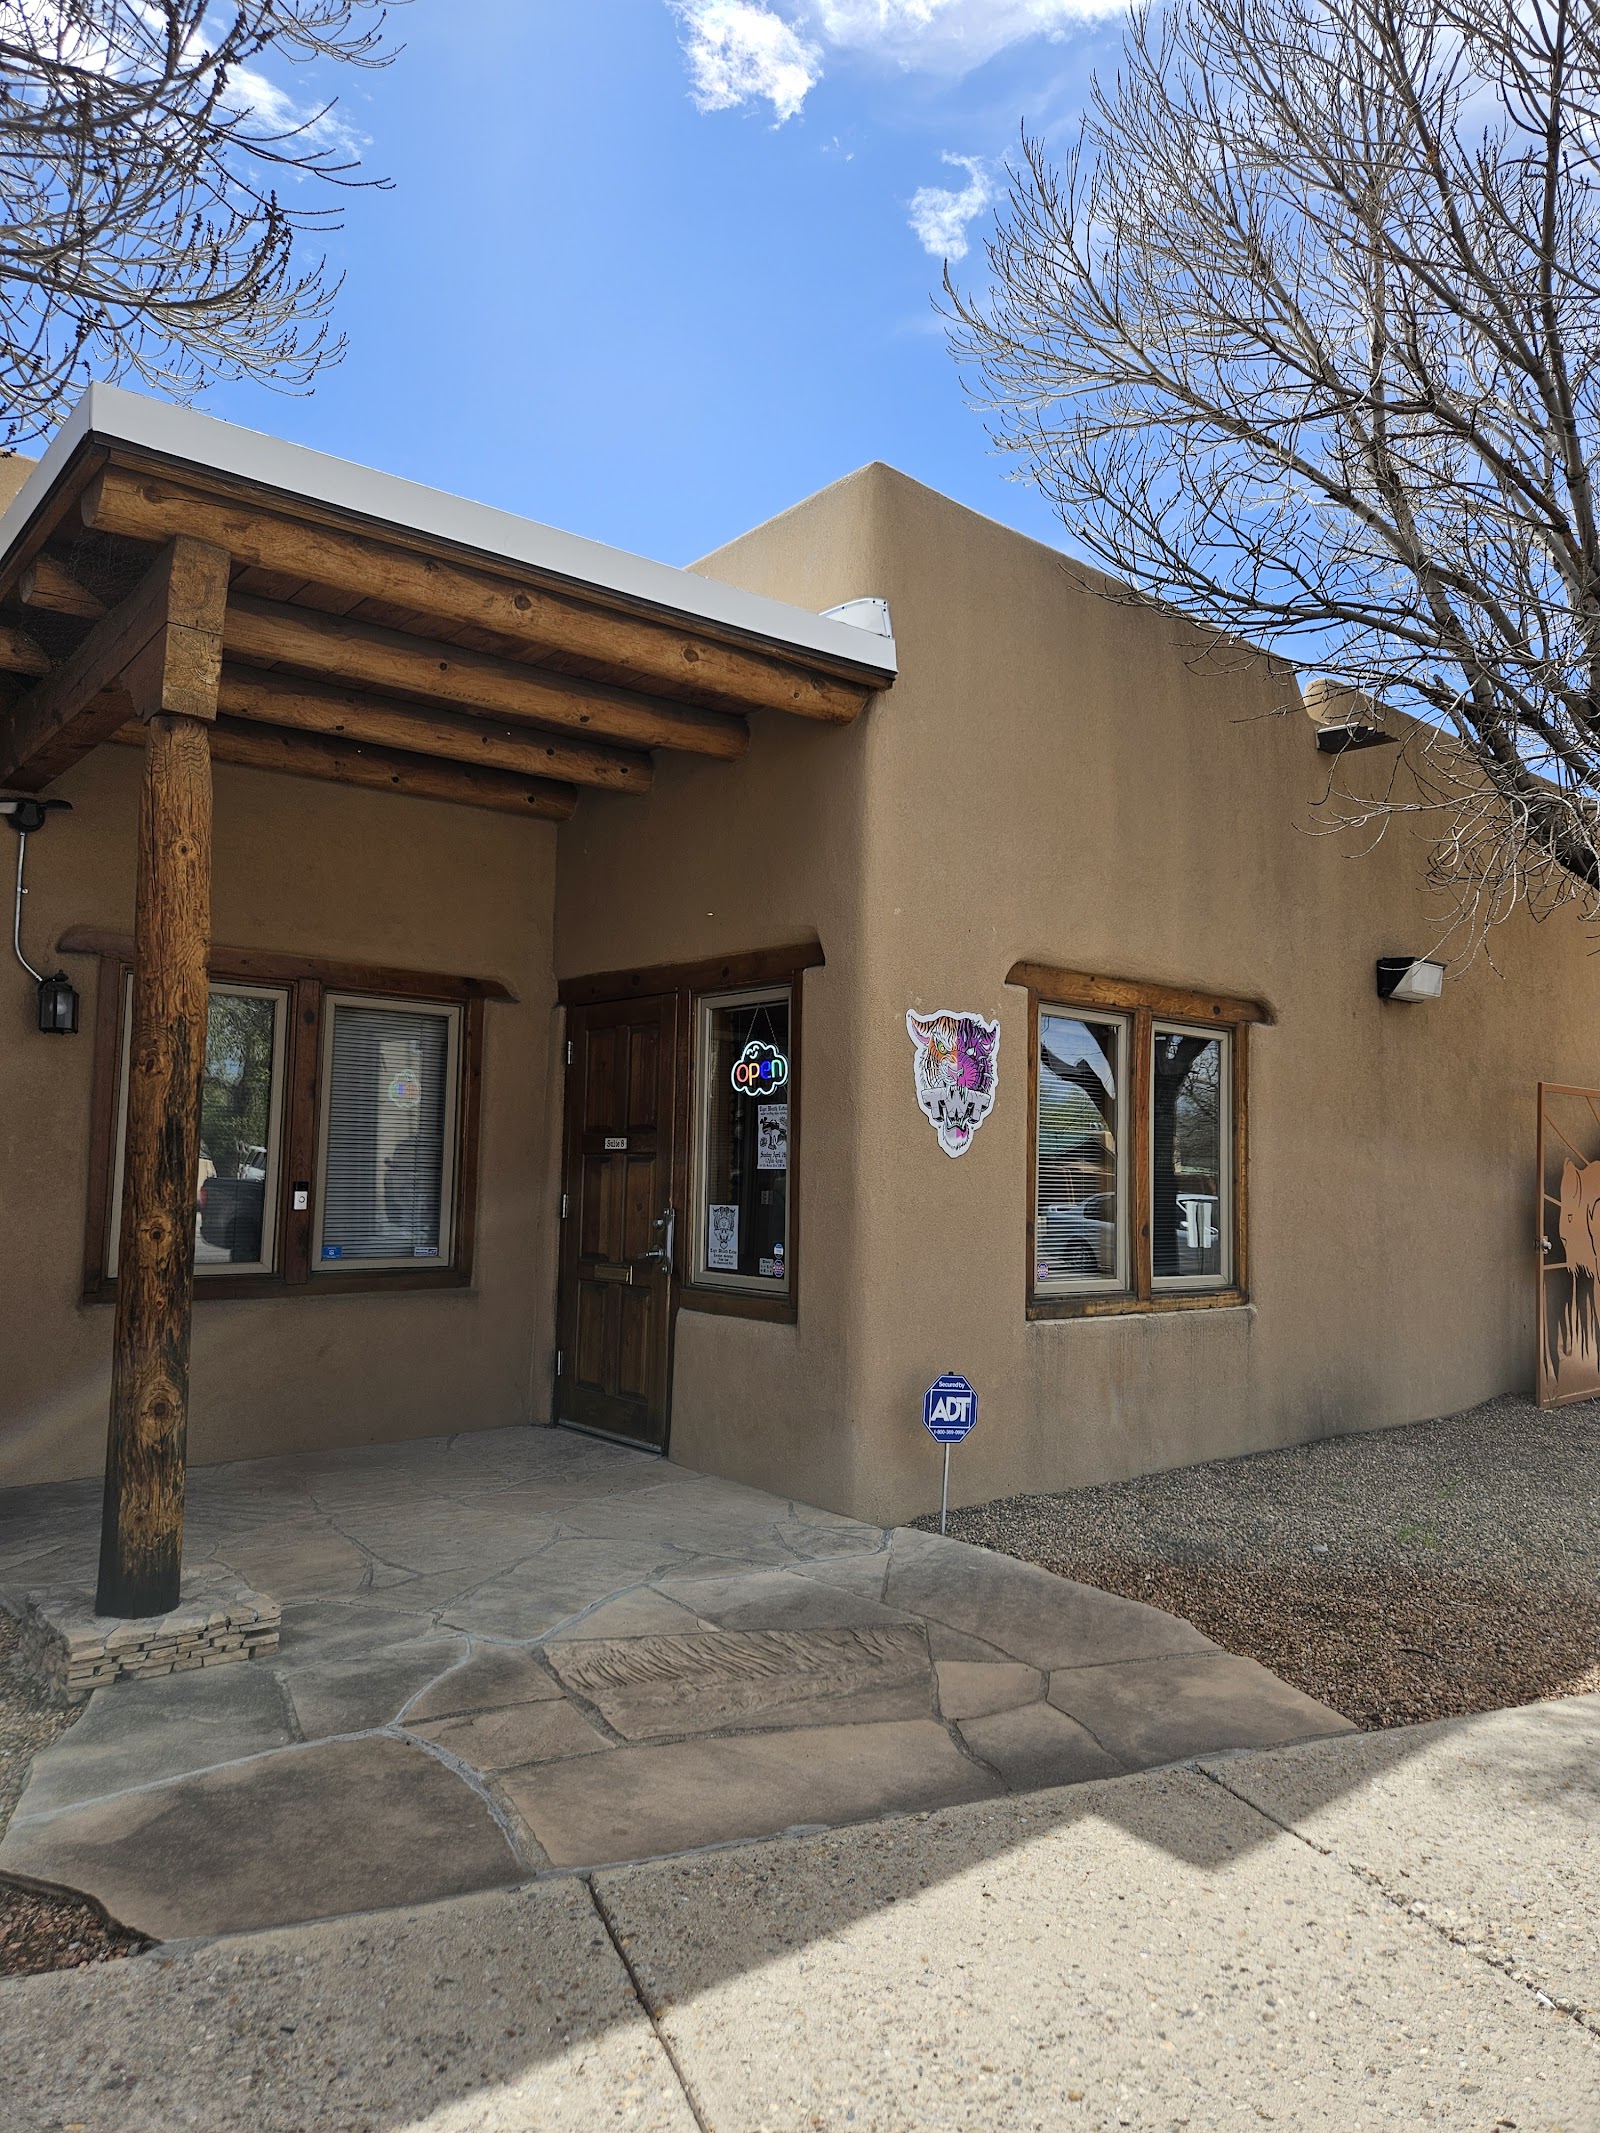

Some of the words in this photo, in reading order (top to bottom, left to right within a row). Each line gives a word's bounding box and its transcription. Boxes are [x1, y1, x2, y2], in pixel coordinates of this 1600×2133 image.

[736, 1059, 783, 1086] open
[606, 1139, 620, 1148] Suite
[620, 1139, 625, 1148] 8
[930, 1396, 971, 1422] ADT
